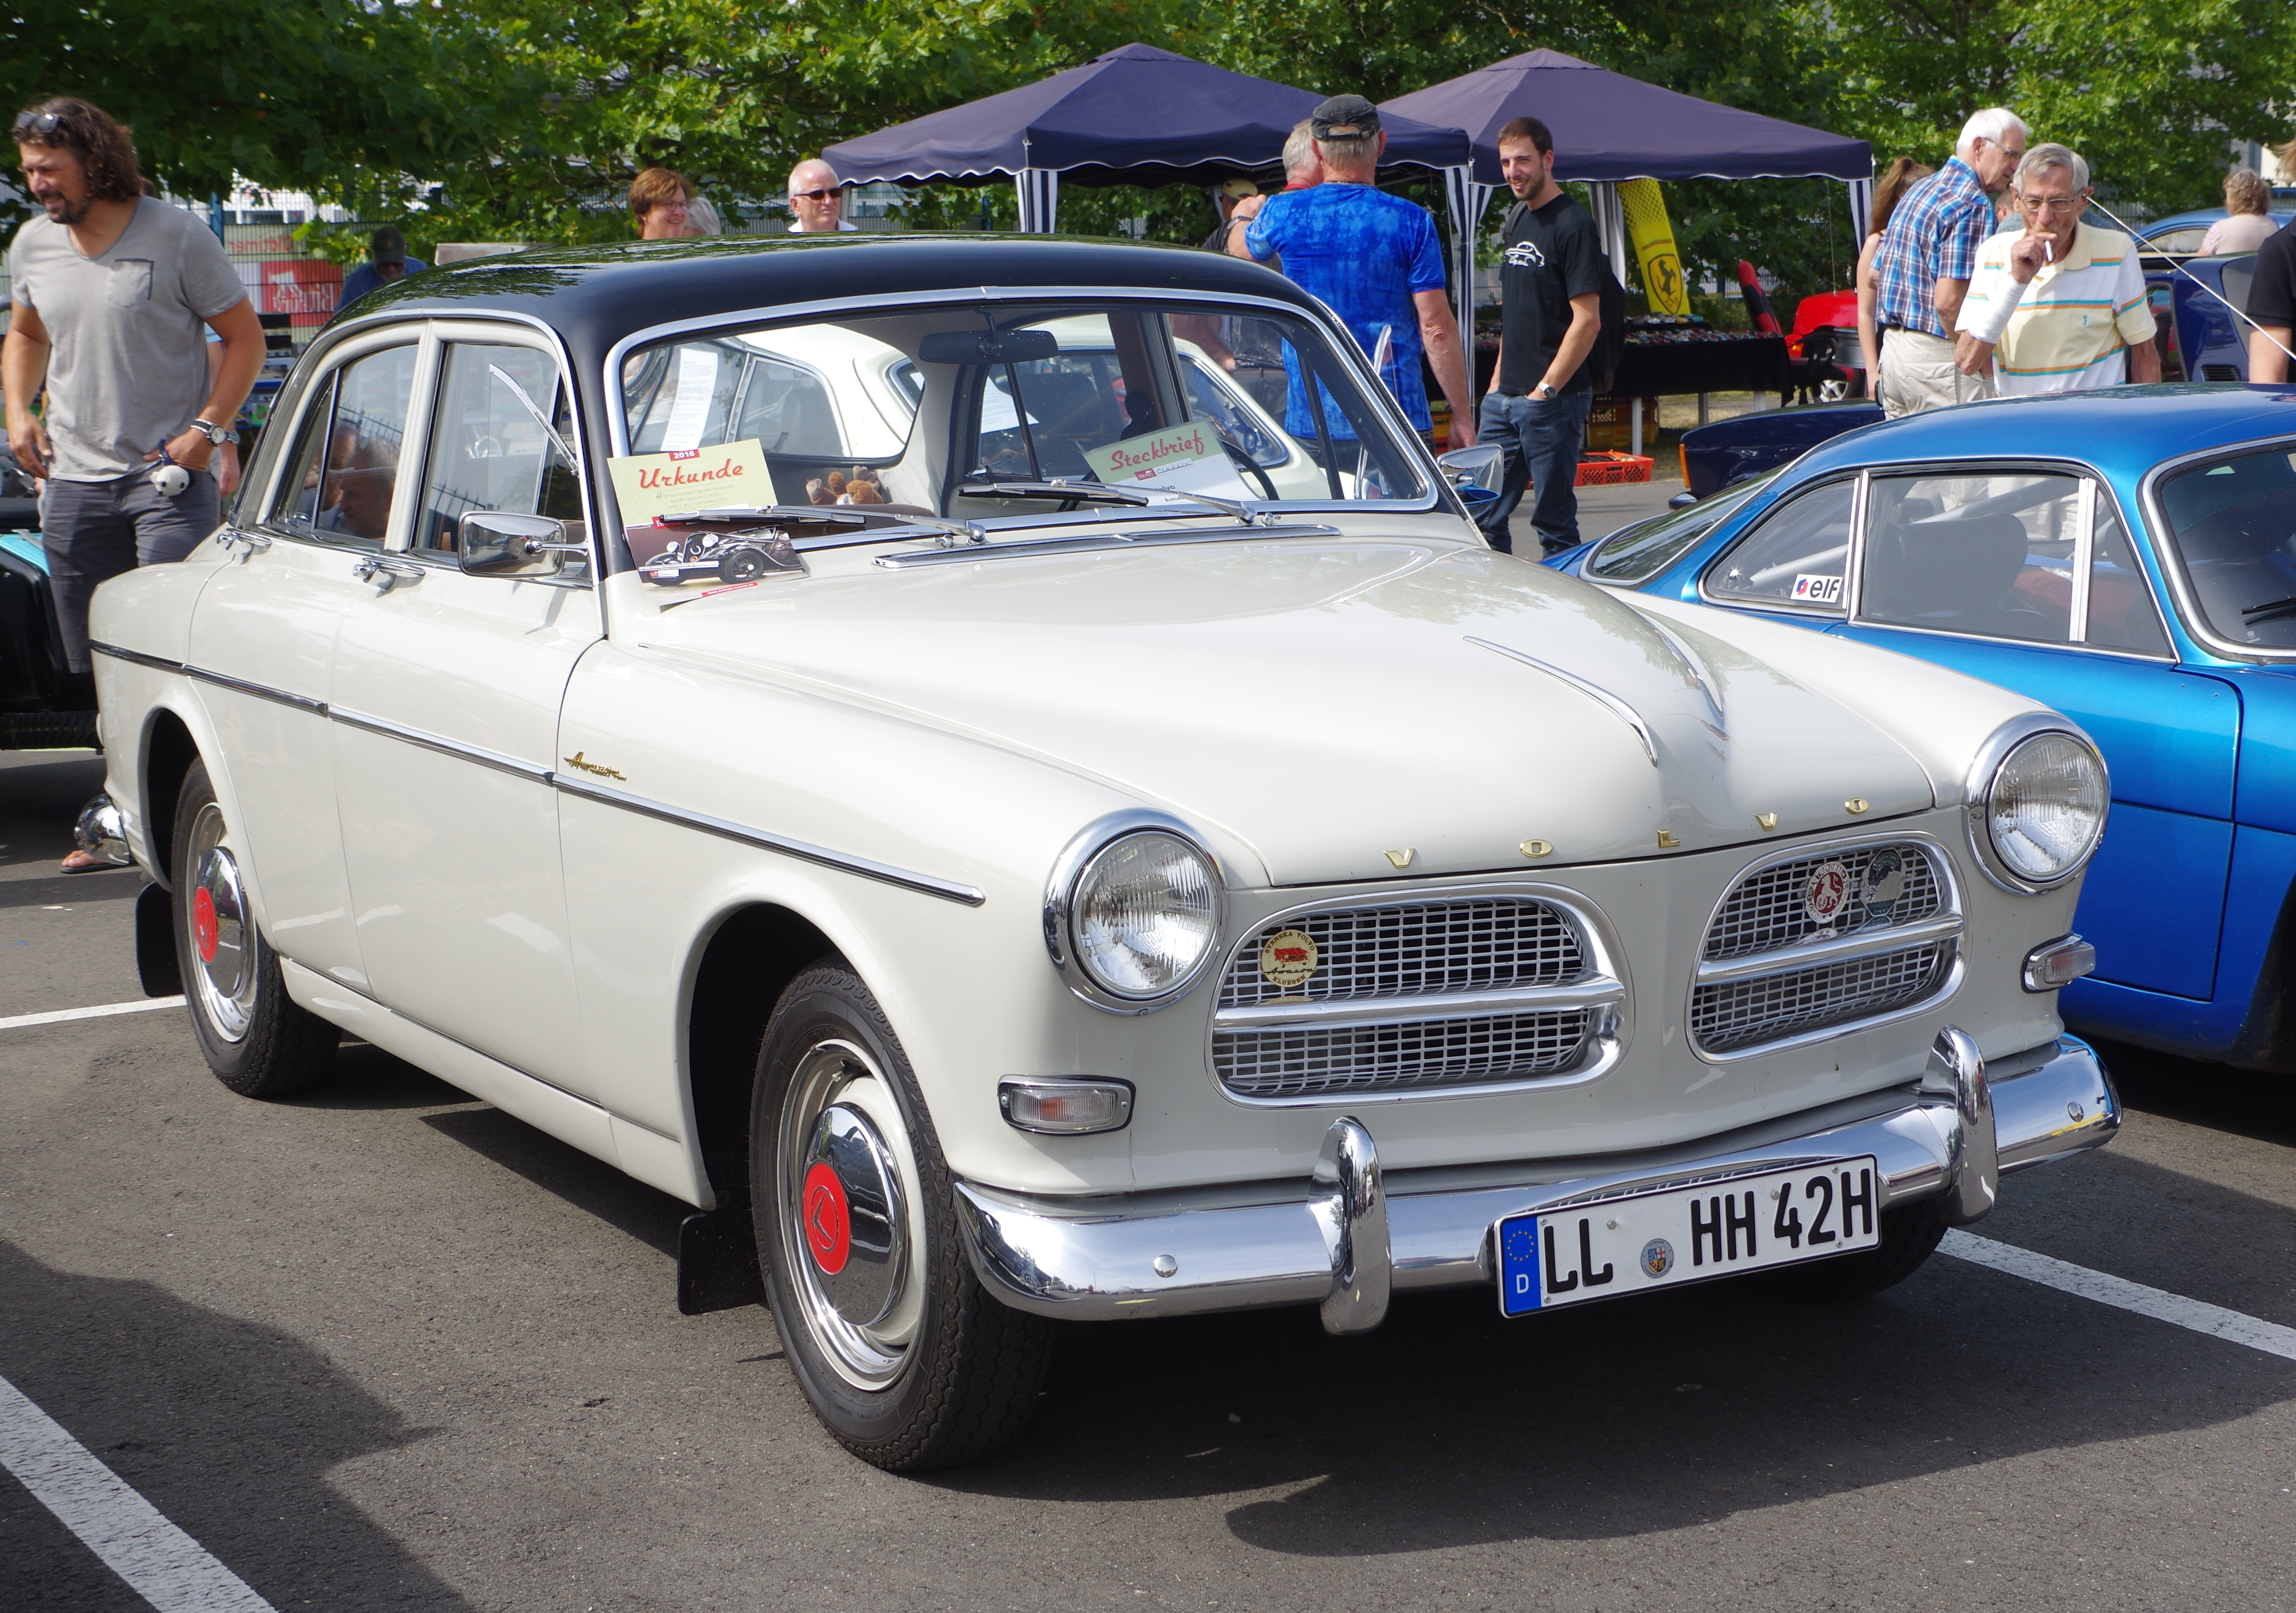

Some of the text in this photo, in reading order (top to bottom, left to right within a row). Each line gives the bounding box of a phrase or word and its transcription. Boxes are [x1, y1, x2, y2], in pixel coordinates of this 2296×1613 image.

[673, 451, 695, 459] 2016
[1111, 429, 1204, 471] Steckbrief
[638, 458, 744, 489] Urkunde
[1157, 463, 1192, 474] Classic
[1810, 579, 1840, 599] elf
[1265, 931, 1315, 954] SVENSKA VOLVO
[1272, 975, 1306, 985] KLUBBEN
[911, 1128, 930, 1194] SPRINT
[1544, 1168, 1872, 1294] LL HH 42H
[1516, 1274, 1529, 1294] D
